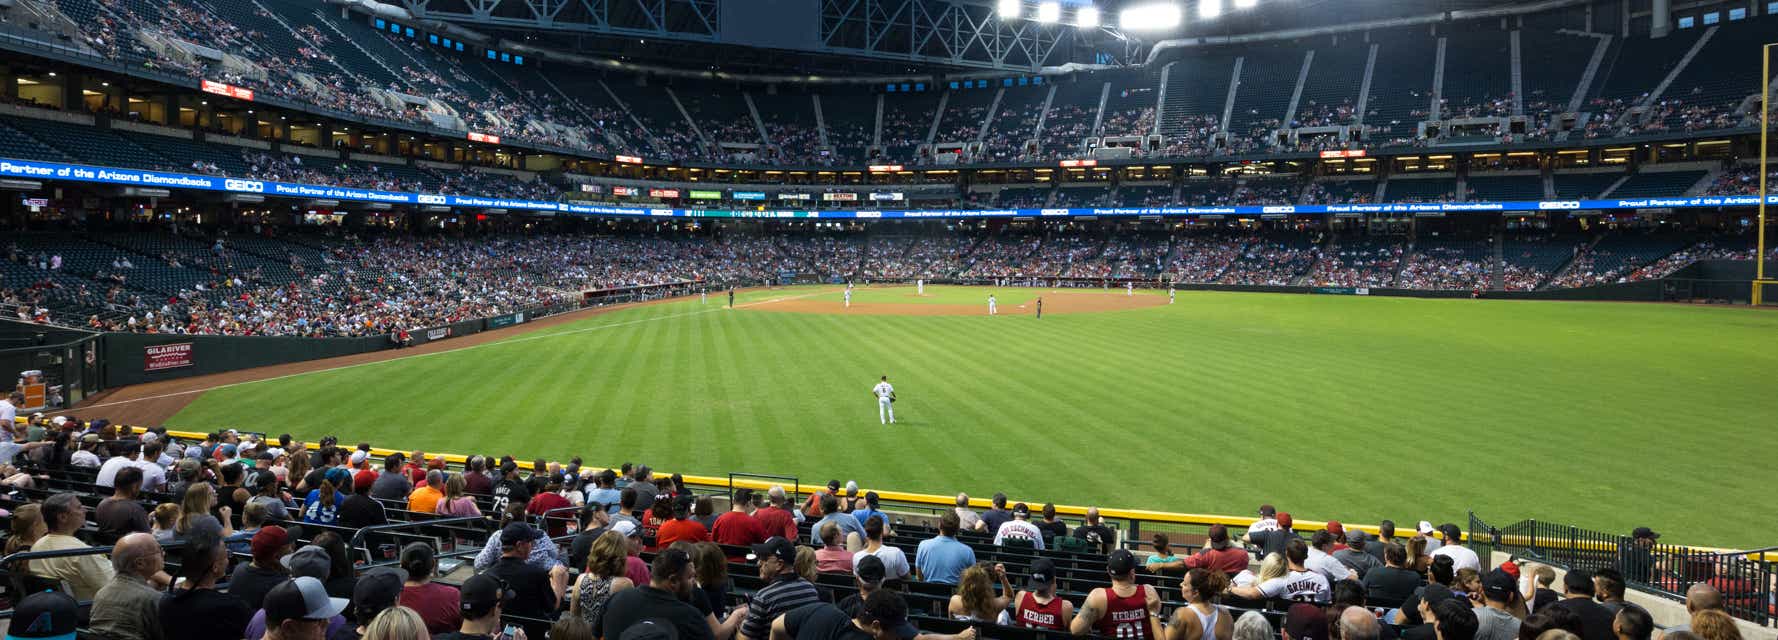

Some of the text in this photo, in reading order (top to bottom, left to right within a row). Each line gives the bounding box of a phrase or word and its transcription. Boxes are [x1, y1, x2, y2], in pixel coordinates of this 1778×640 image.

[0, 162, 212, 187] Partner of the Arizona Diamondbacks
[225, 179, 264, 192] GEICO
[276, 185, 298, 194] Proud
[300, 187, 324, 196] Partner
[418, 195, 446, 204] GEICO
[1539, 201, 1580, 209] GEICO
[492, 496, 509, 512] 79
[1287, 580, 1322, 594] GREINKE
[1023, 608, 1055, 625] KERBER
[1112, 608, 1146, 622] KERBER
